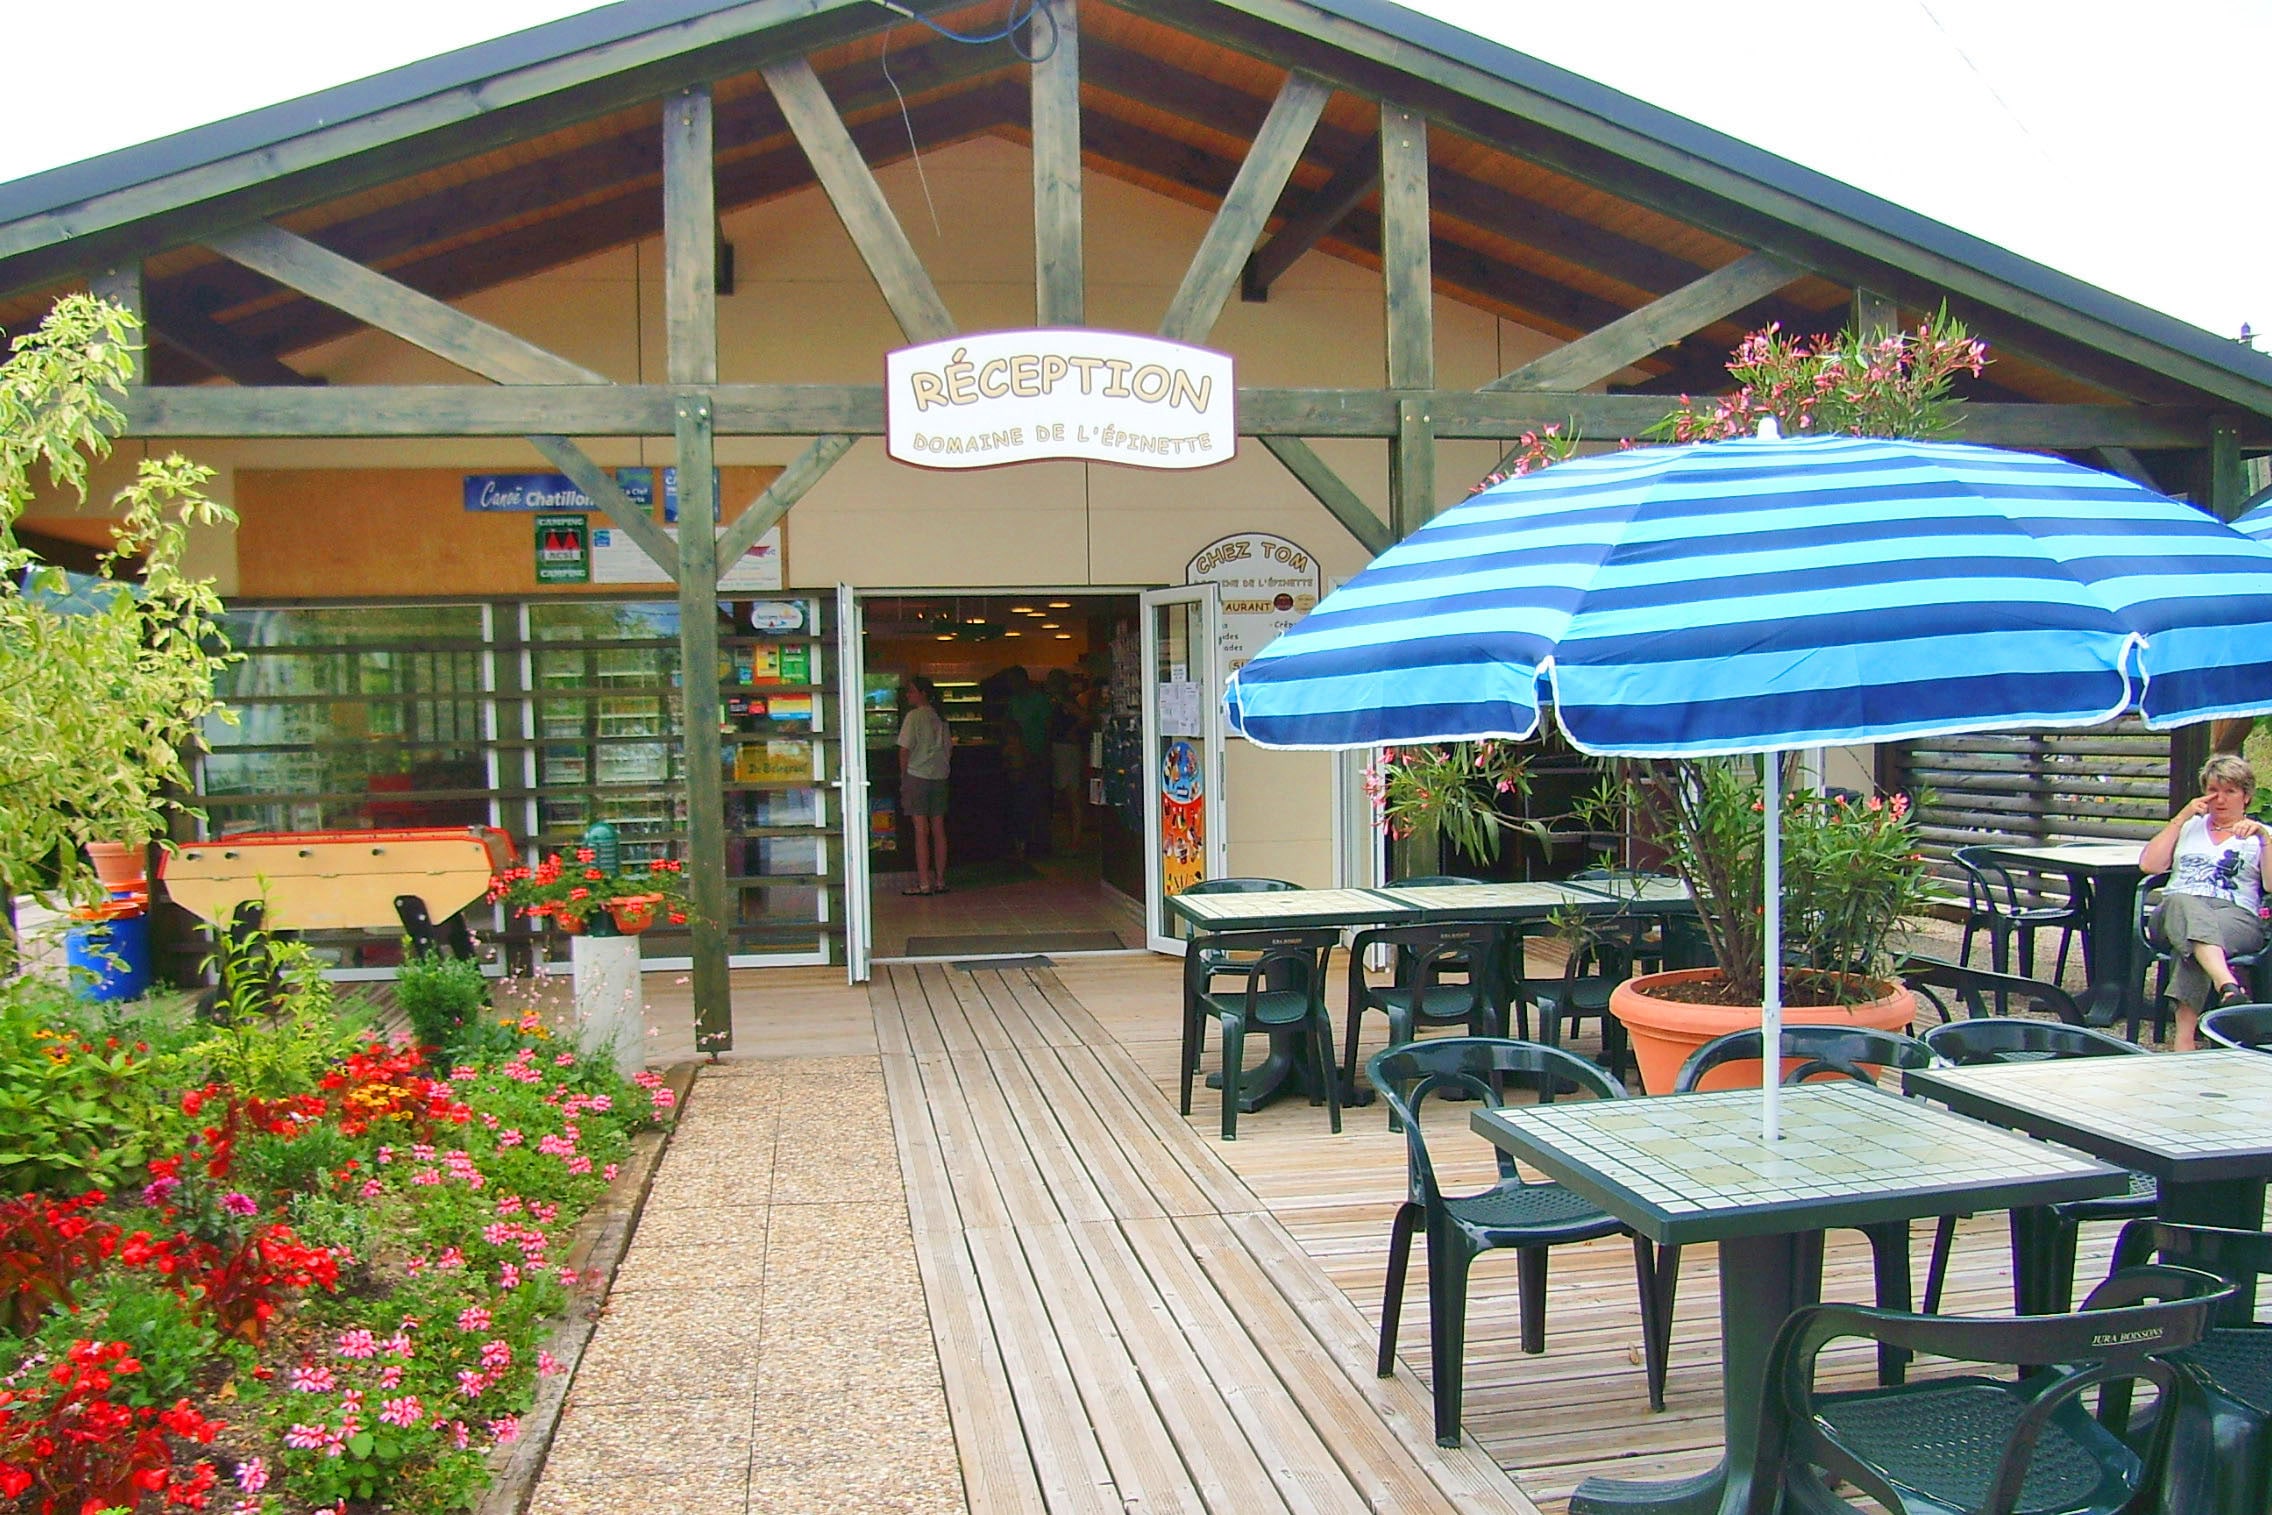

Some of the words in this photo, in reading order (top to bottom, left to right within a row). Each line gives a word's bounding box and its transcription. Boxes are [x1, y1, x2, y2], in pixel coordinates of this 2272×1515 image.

[911, 347, 1212, 414] RÉCEPTION
[913, 427, 1023, 454] DOMAINE
[1036, 423, 1065, 442] DE
[1077, 424, 1213, 455] L'ÉPINETTE
[1196, 541, 1251, 574] CHEZ
[1261, 541, 1308, 573] TOM
[1226, 602, 1270, 612] AURANT
[2093, 1334, 2118, 1345] JURA
[2121, 1328, 2164, 1342] BOISSONS
